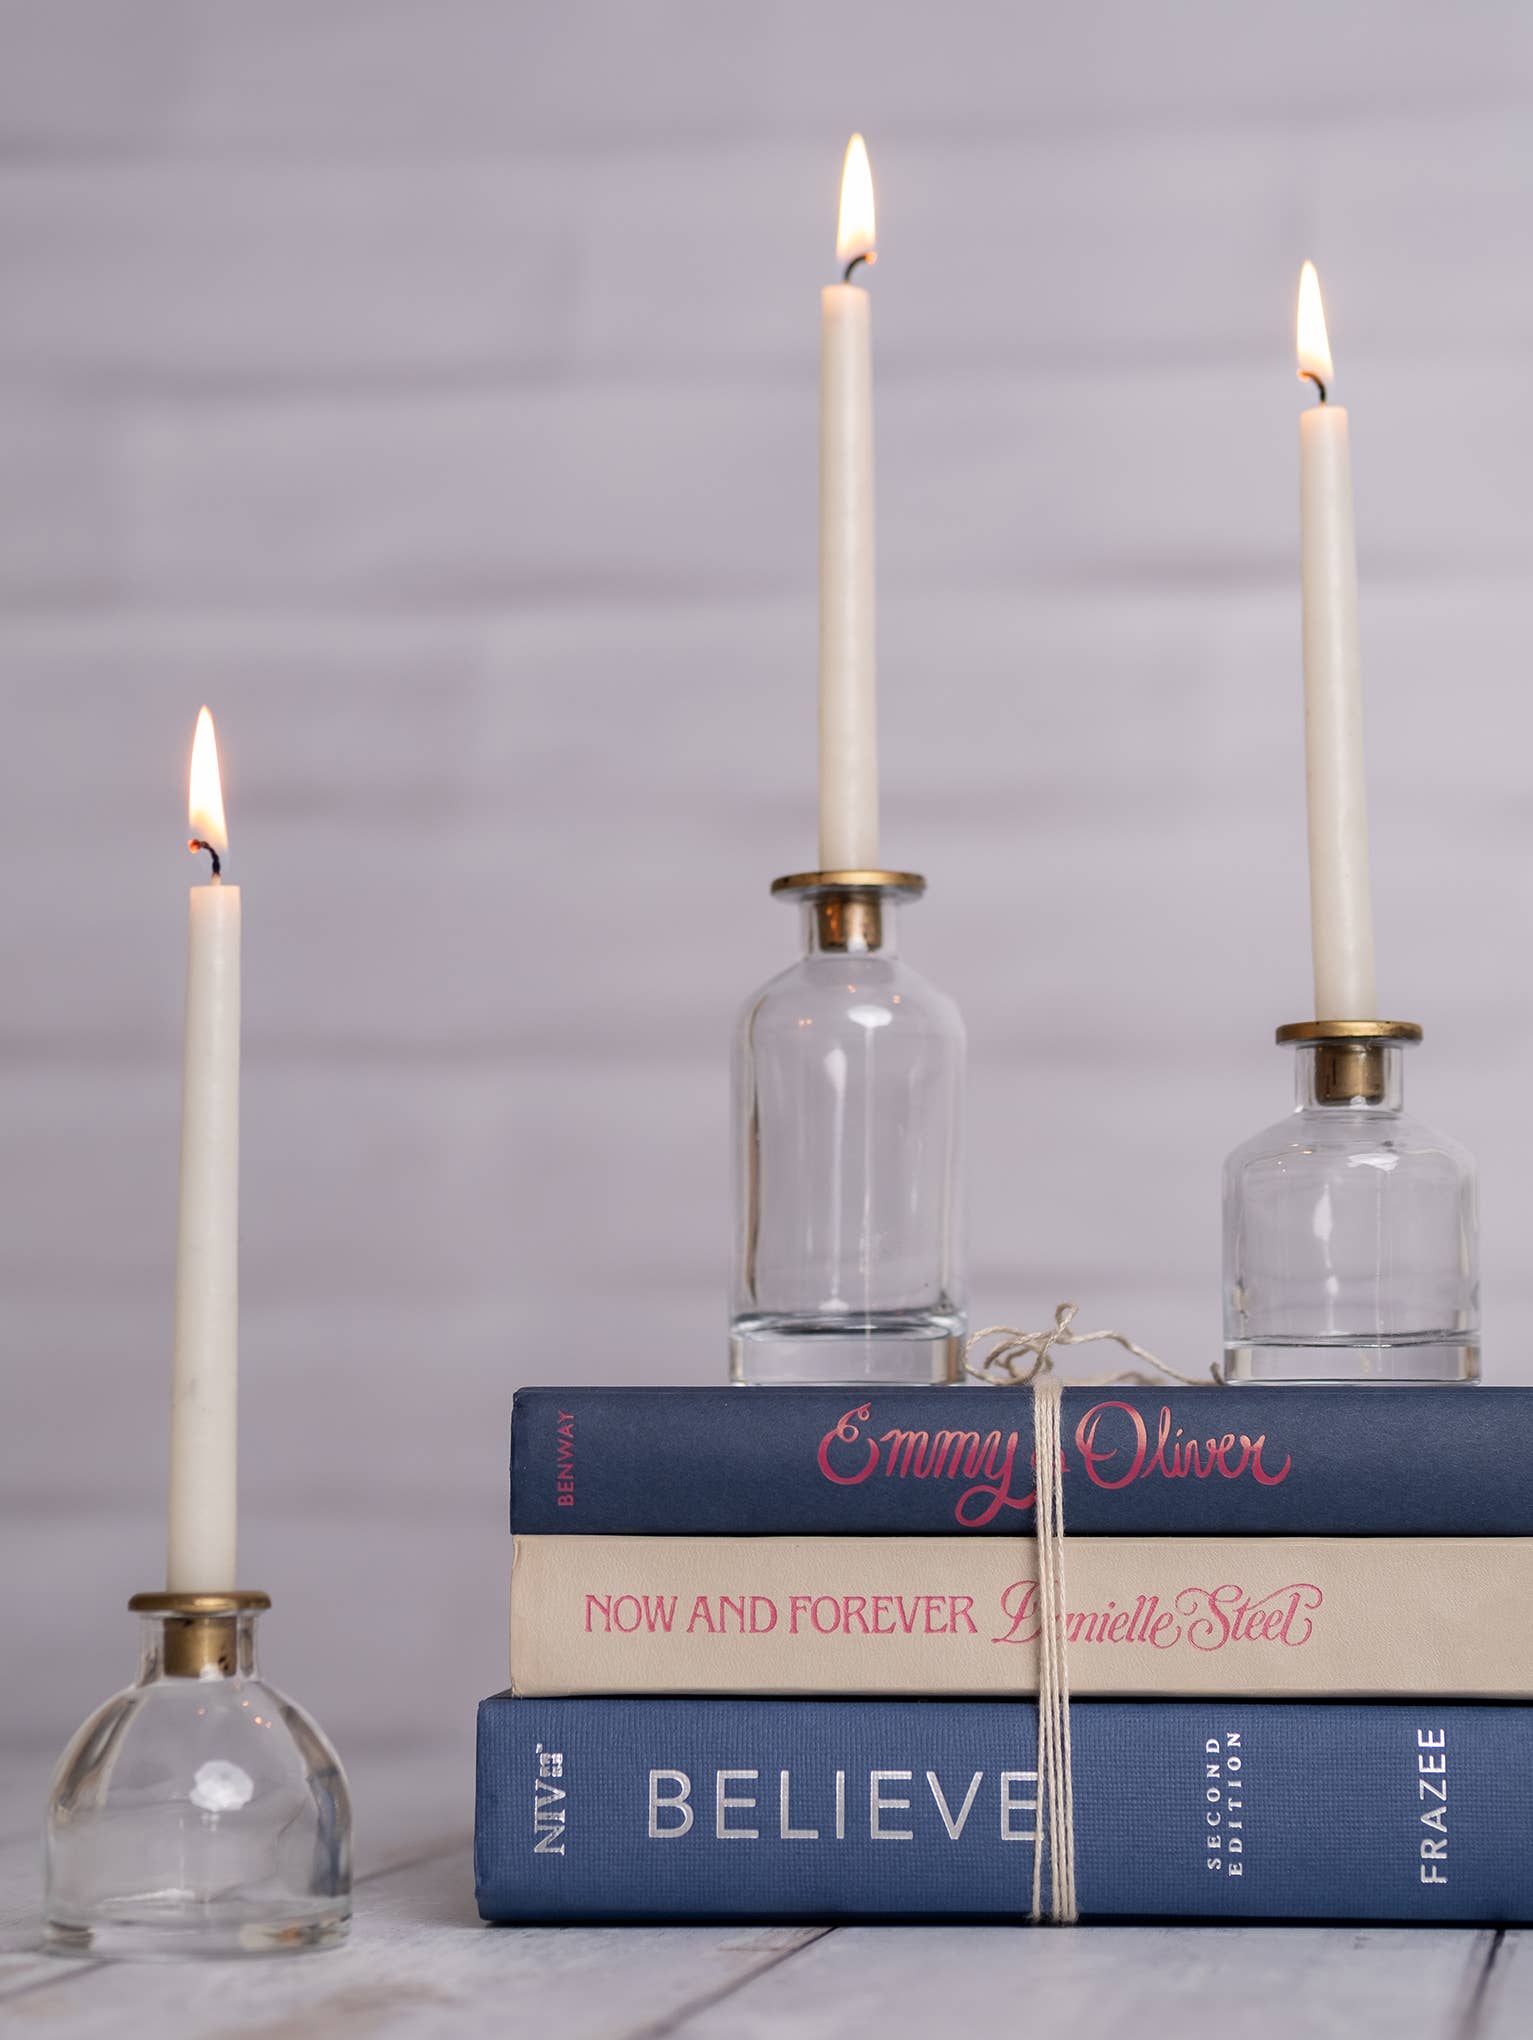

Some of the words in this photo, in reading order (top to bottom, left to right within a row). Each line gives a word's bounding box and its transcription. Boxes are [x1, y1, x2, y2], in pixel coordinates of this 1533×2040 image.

[556, 1410, 576, 1507] BENWAY
[816, 1401, 1037, 1528] Emmy
[1074, 1400, 1293, 1490] Oliver
[583, 1594, 679, 1635] NOW
[686, 1594, 779, 1635] AND
[787, 1594, 979, 1636] FOREVER
[990, 1579, 1183, 1650] Dnielle
[1174, 1582, 1324, 1652] Steel
[533, 1778, 567, 1856] NIV
[647, 1769, 1044, 1841] BELIEVE
[1205, 1737, 1222, 1871] SECOND
[1226, 1731, 1243, 1877] EDITION
[1417, 1727, 1449, 1885] FRAZEE
